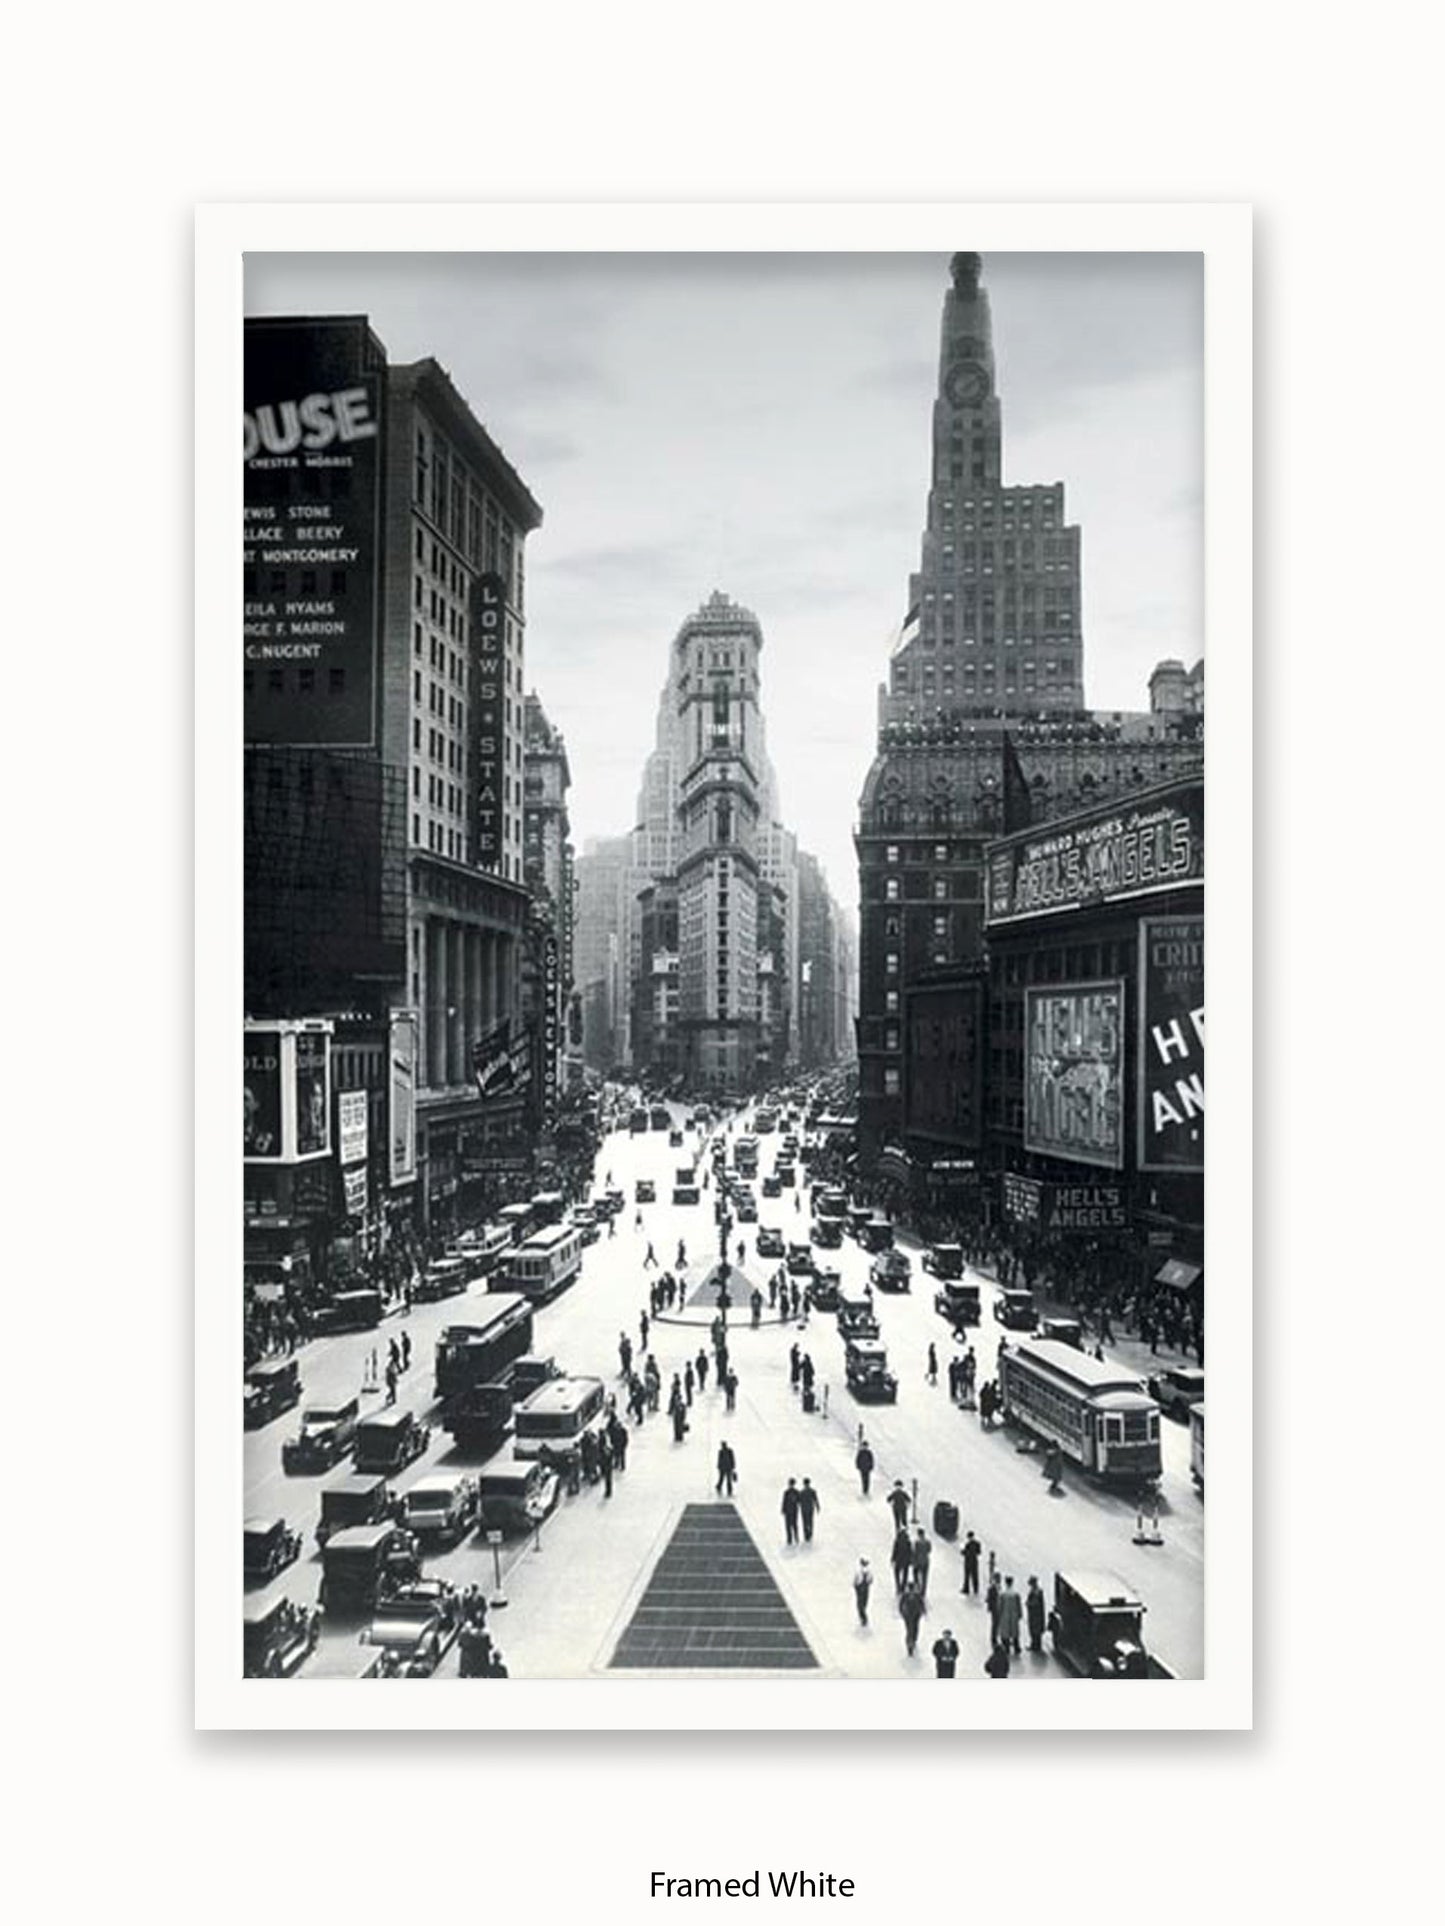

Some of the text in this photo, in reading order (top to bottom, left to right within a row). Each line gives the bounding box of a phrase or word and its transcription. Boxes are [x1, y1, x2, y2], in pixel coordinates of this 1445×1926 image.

[288, 505, 331, 519] STONE
[297, 525, 345, 540] BEERY
[262, 547, 360, 562] MONTGOMERY
[291, 621, 345, 635] MARION
[480, 587, 500, 850] LOEWS STATE
[1075, 819, 1124, 844] HUGHES
[1083, 817, 1190, 894] ANGELS
[1056, 1188, 1120, 1207] HELL'S
[1049, 1207, 1125, 1227] ANGELS
